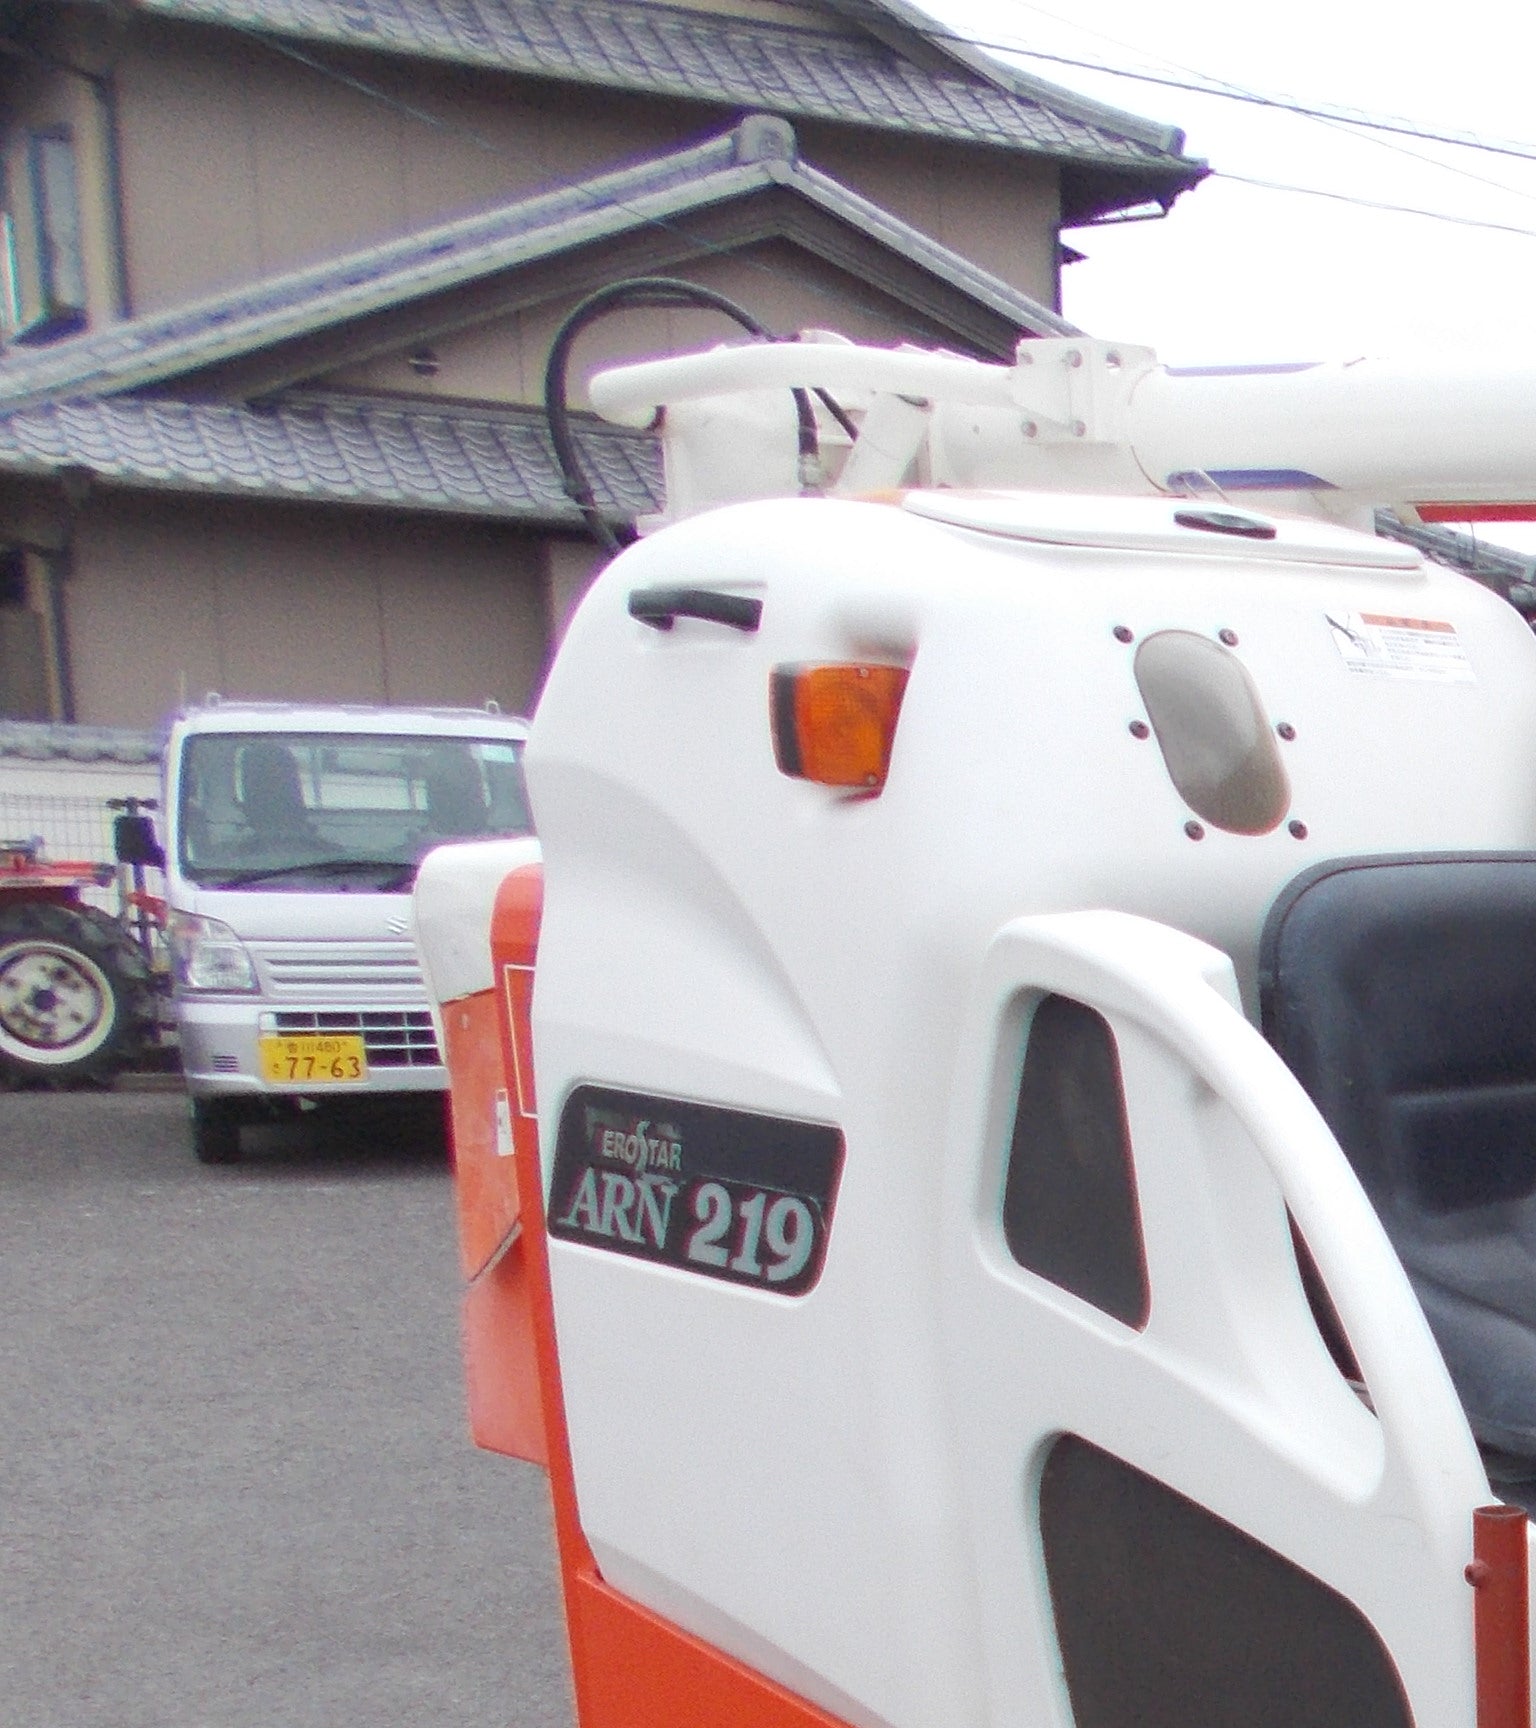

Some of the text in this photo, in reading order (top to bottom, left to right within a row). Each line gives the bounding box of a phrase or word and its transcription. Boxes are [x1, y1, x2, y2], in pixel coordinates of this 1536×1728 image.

[285, 1056, 360, 1079] 77-63
[557, 1166, 814, 1282] ARN 219
